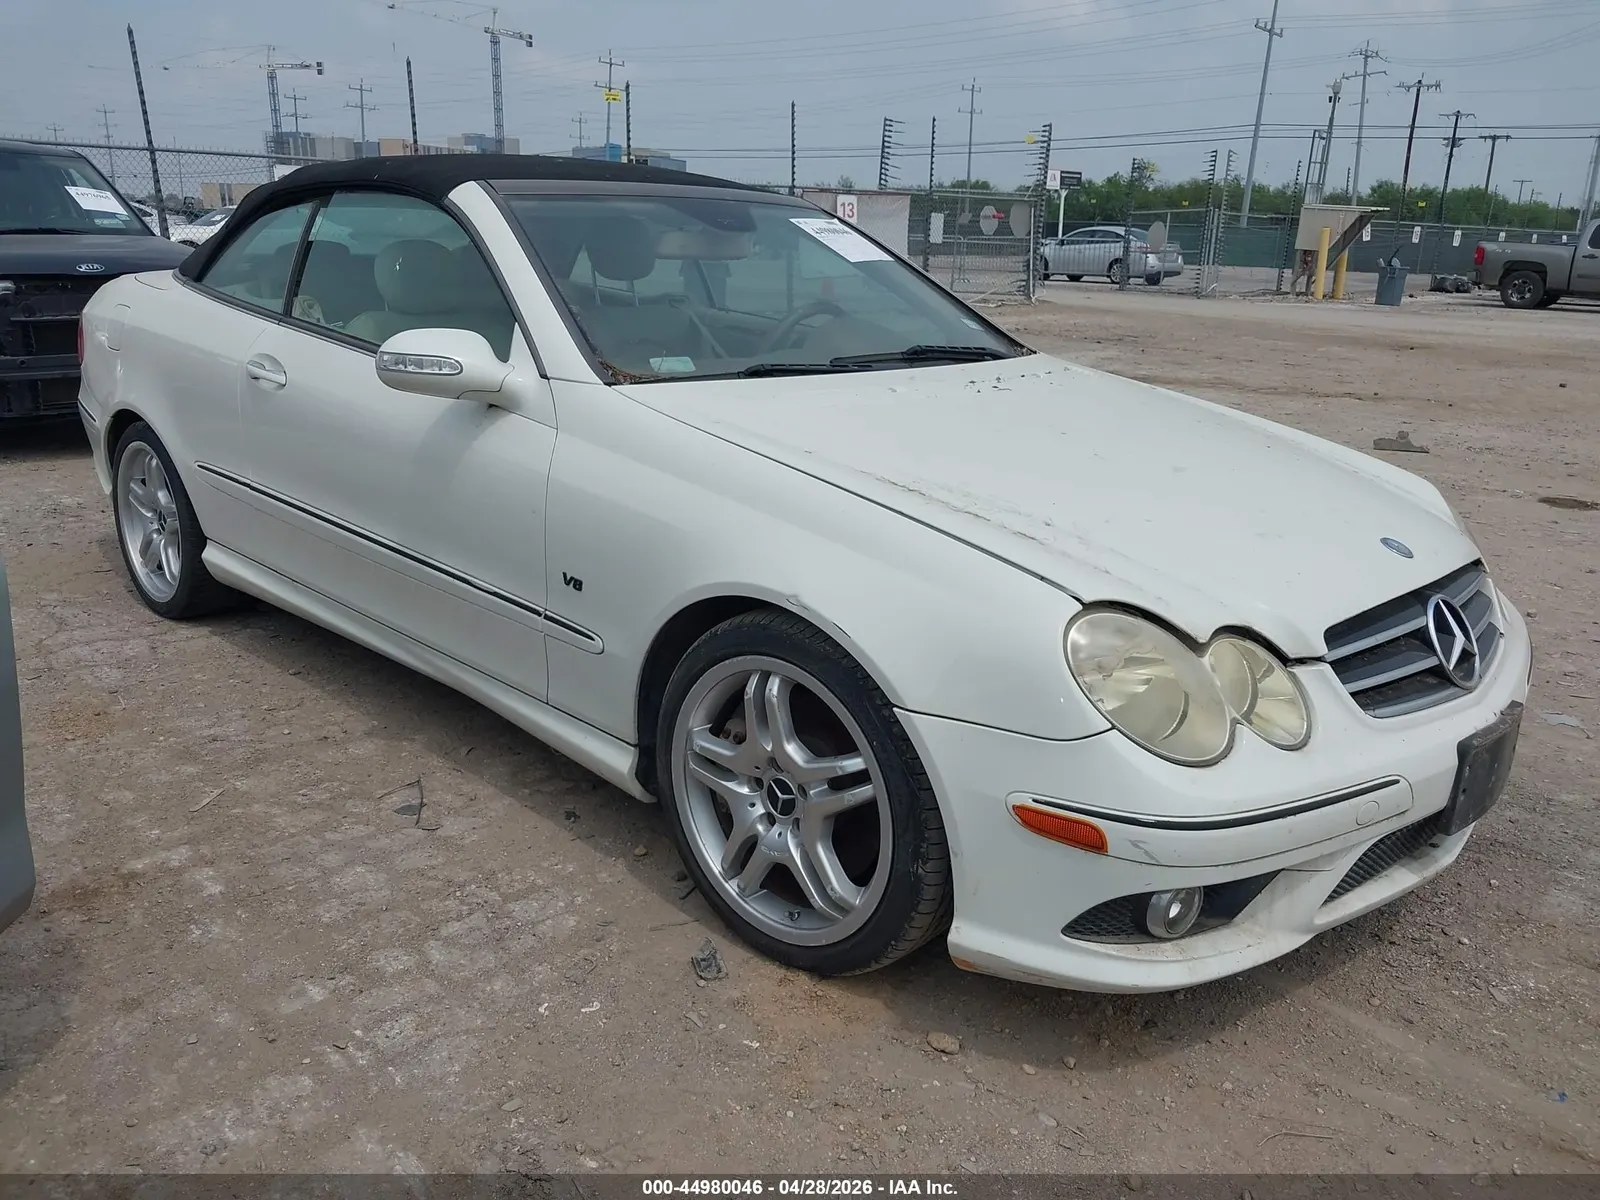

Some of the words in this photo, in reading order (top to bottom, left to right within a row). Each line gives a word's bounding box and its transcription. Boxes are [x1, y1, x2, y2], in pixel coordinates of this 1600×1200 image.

[840, 202, 855, 219] 13
[79, 263, 102, 271] KIA
[562, 571, 583, 592] V8
